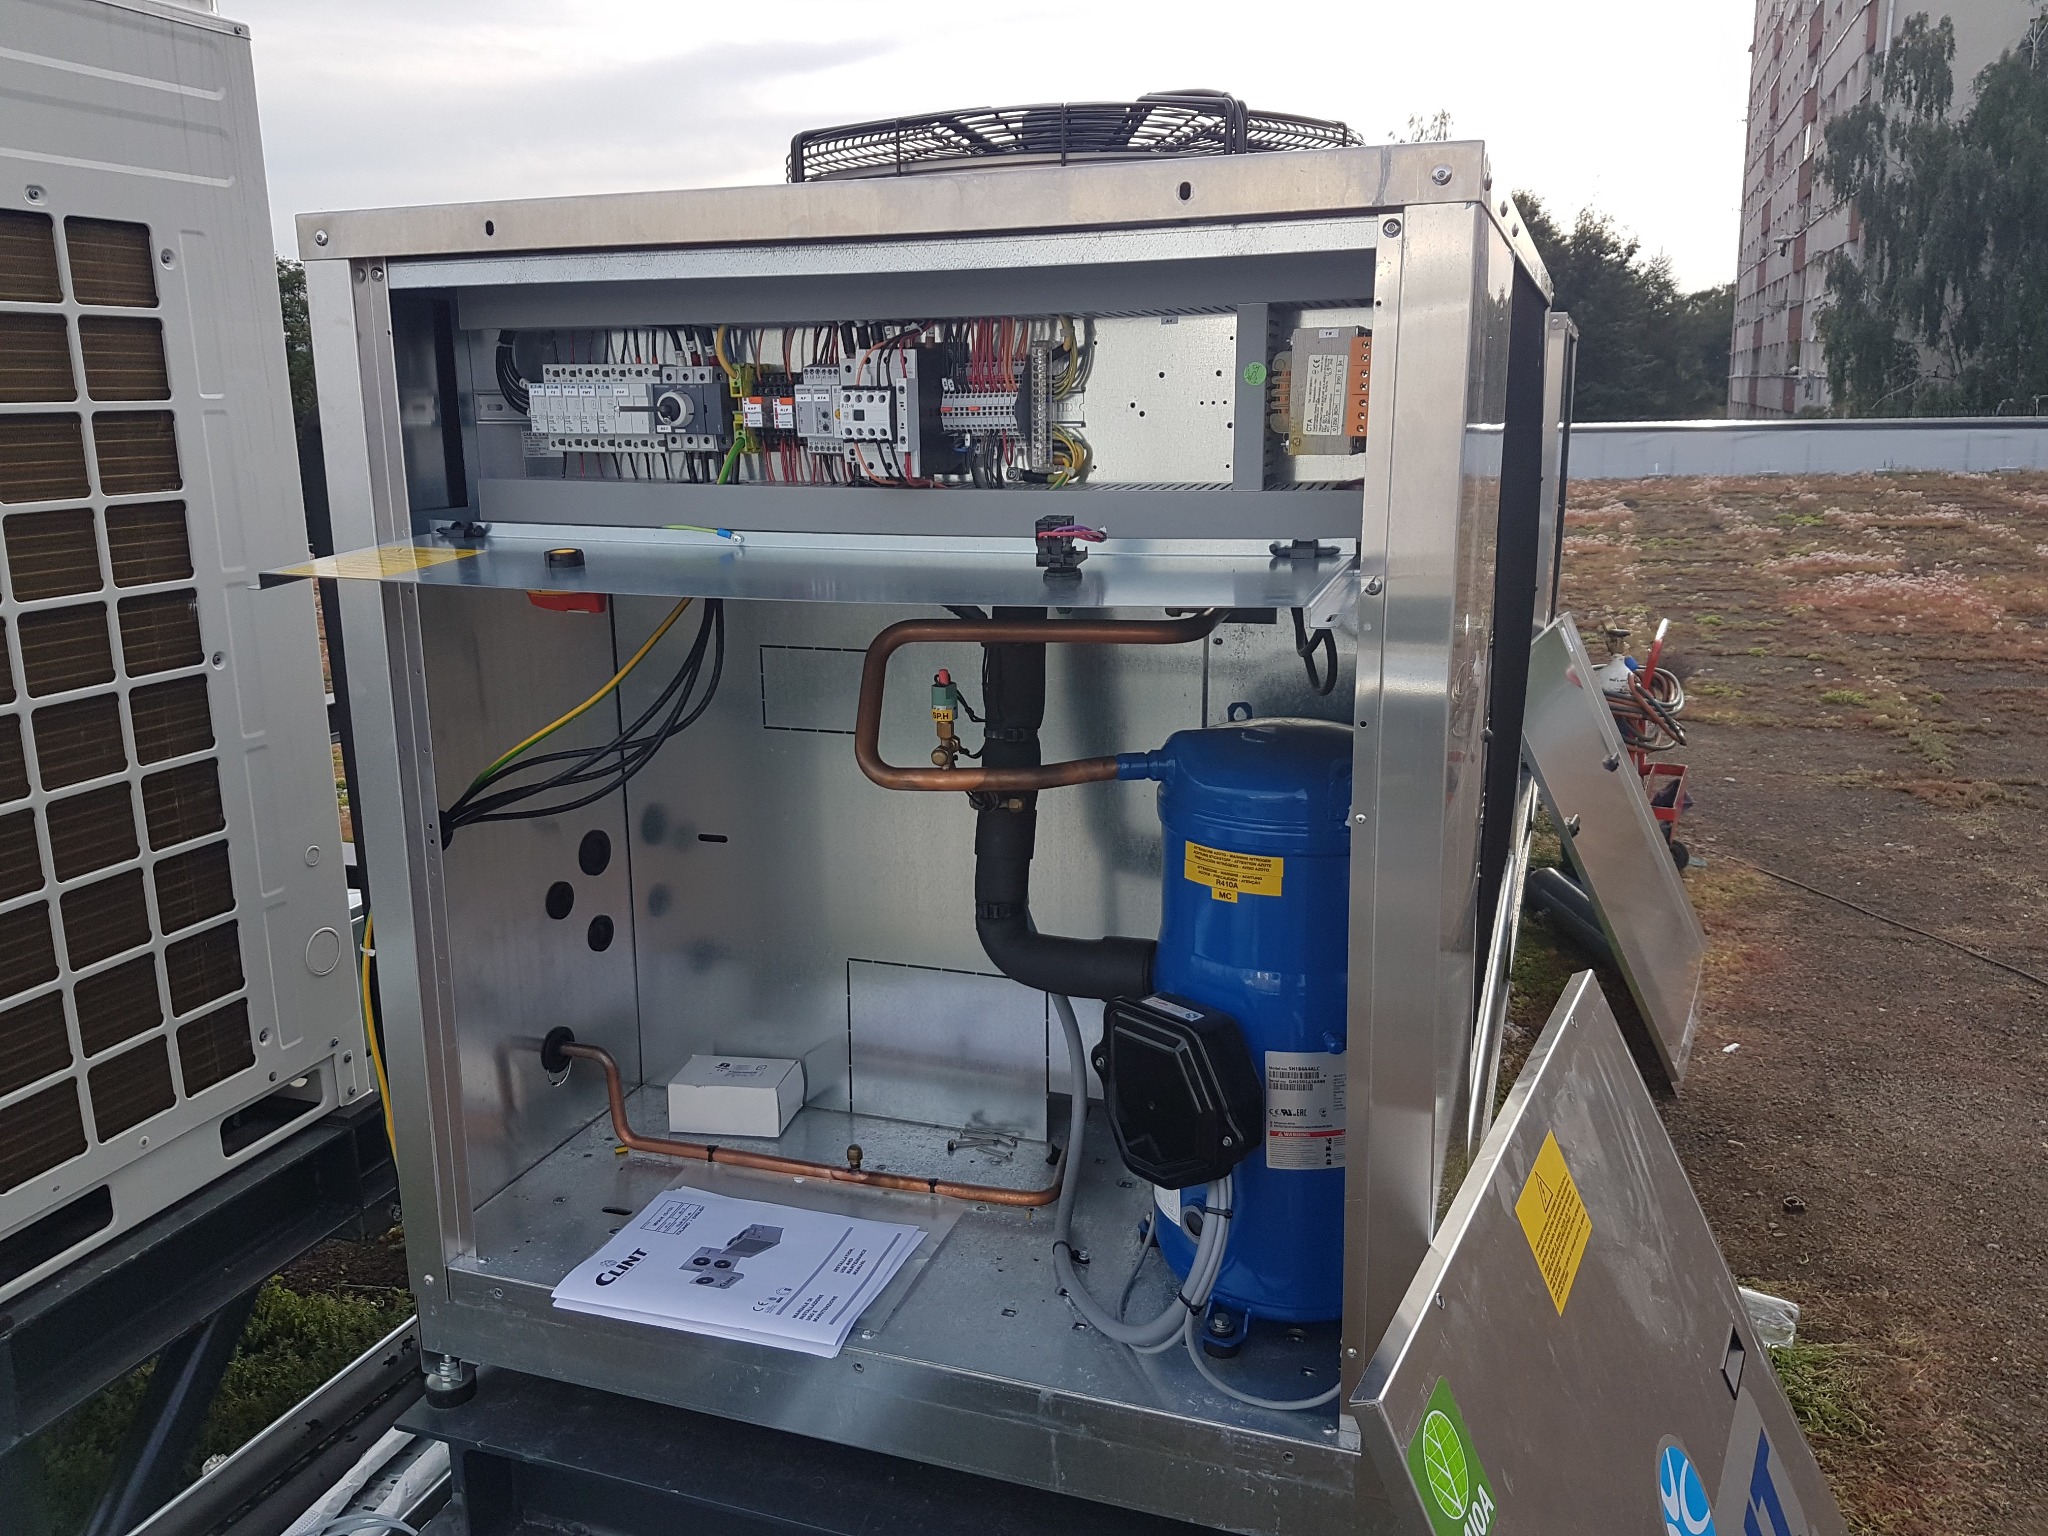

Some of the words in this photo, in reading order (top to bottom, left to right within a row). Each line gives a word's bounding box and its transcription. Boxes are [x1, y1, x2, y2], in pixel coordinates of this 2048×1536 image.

[1216, 879, 1239, 889] R410A
[1218, 892, 1232, 900] MC
[596, 1248, 648, 1286] CLINT
